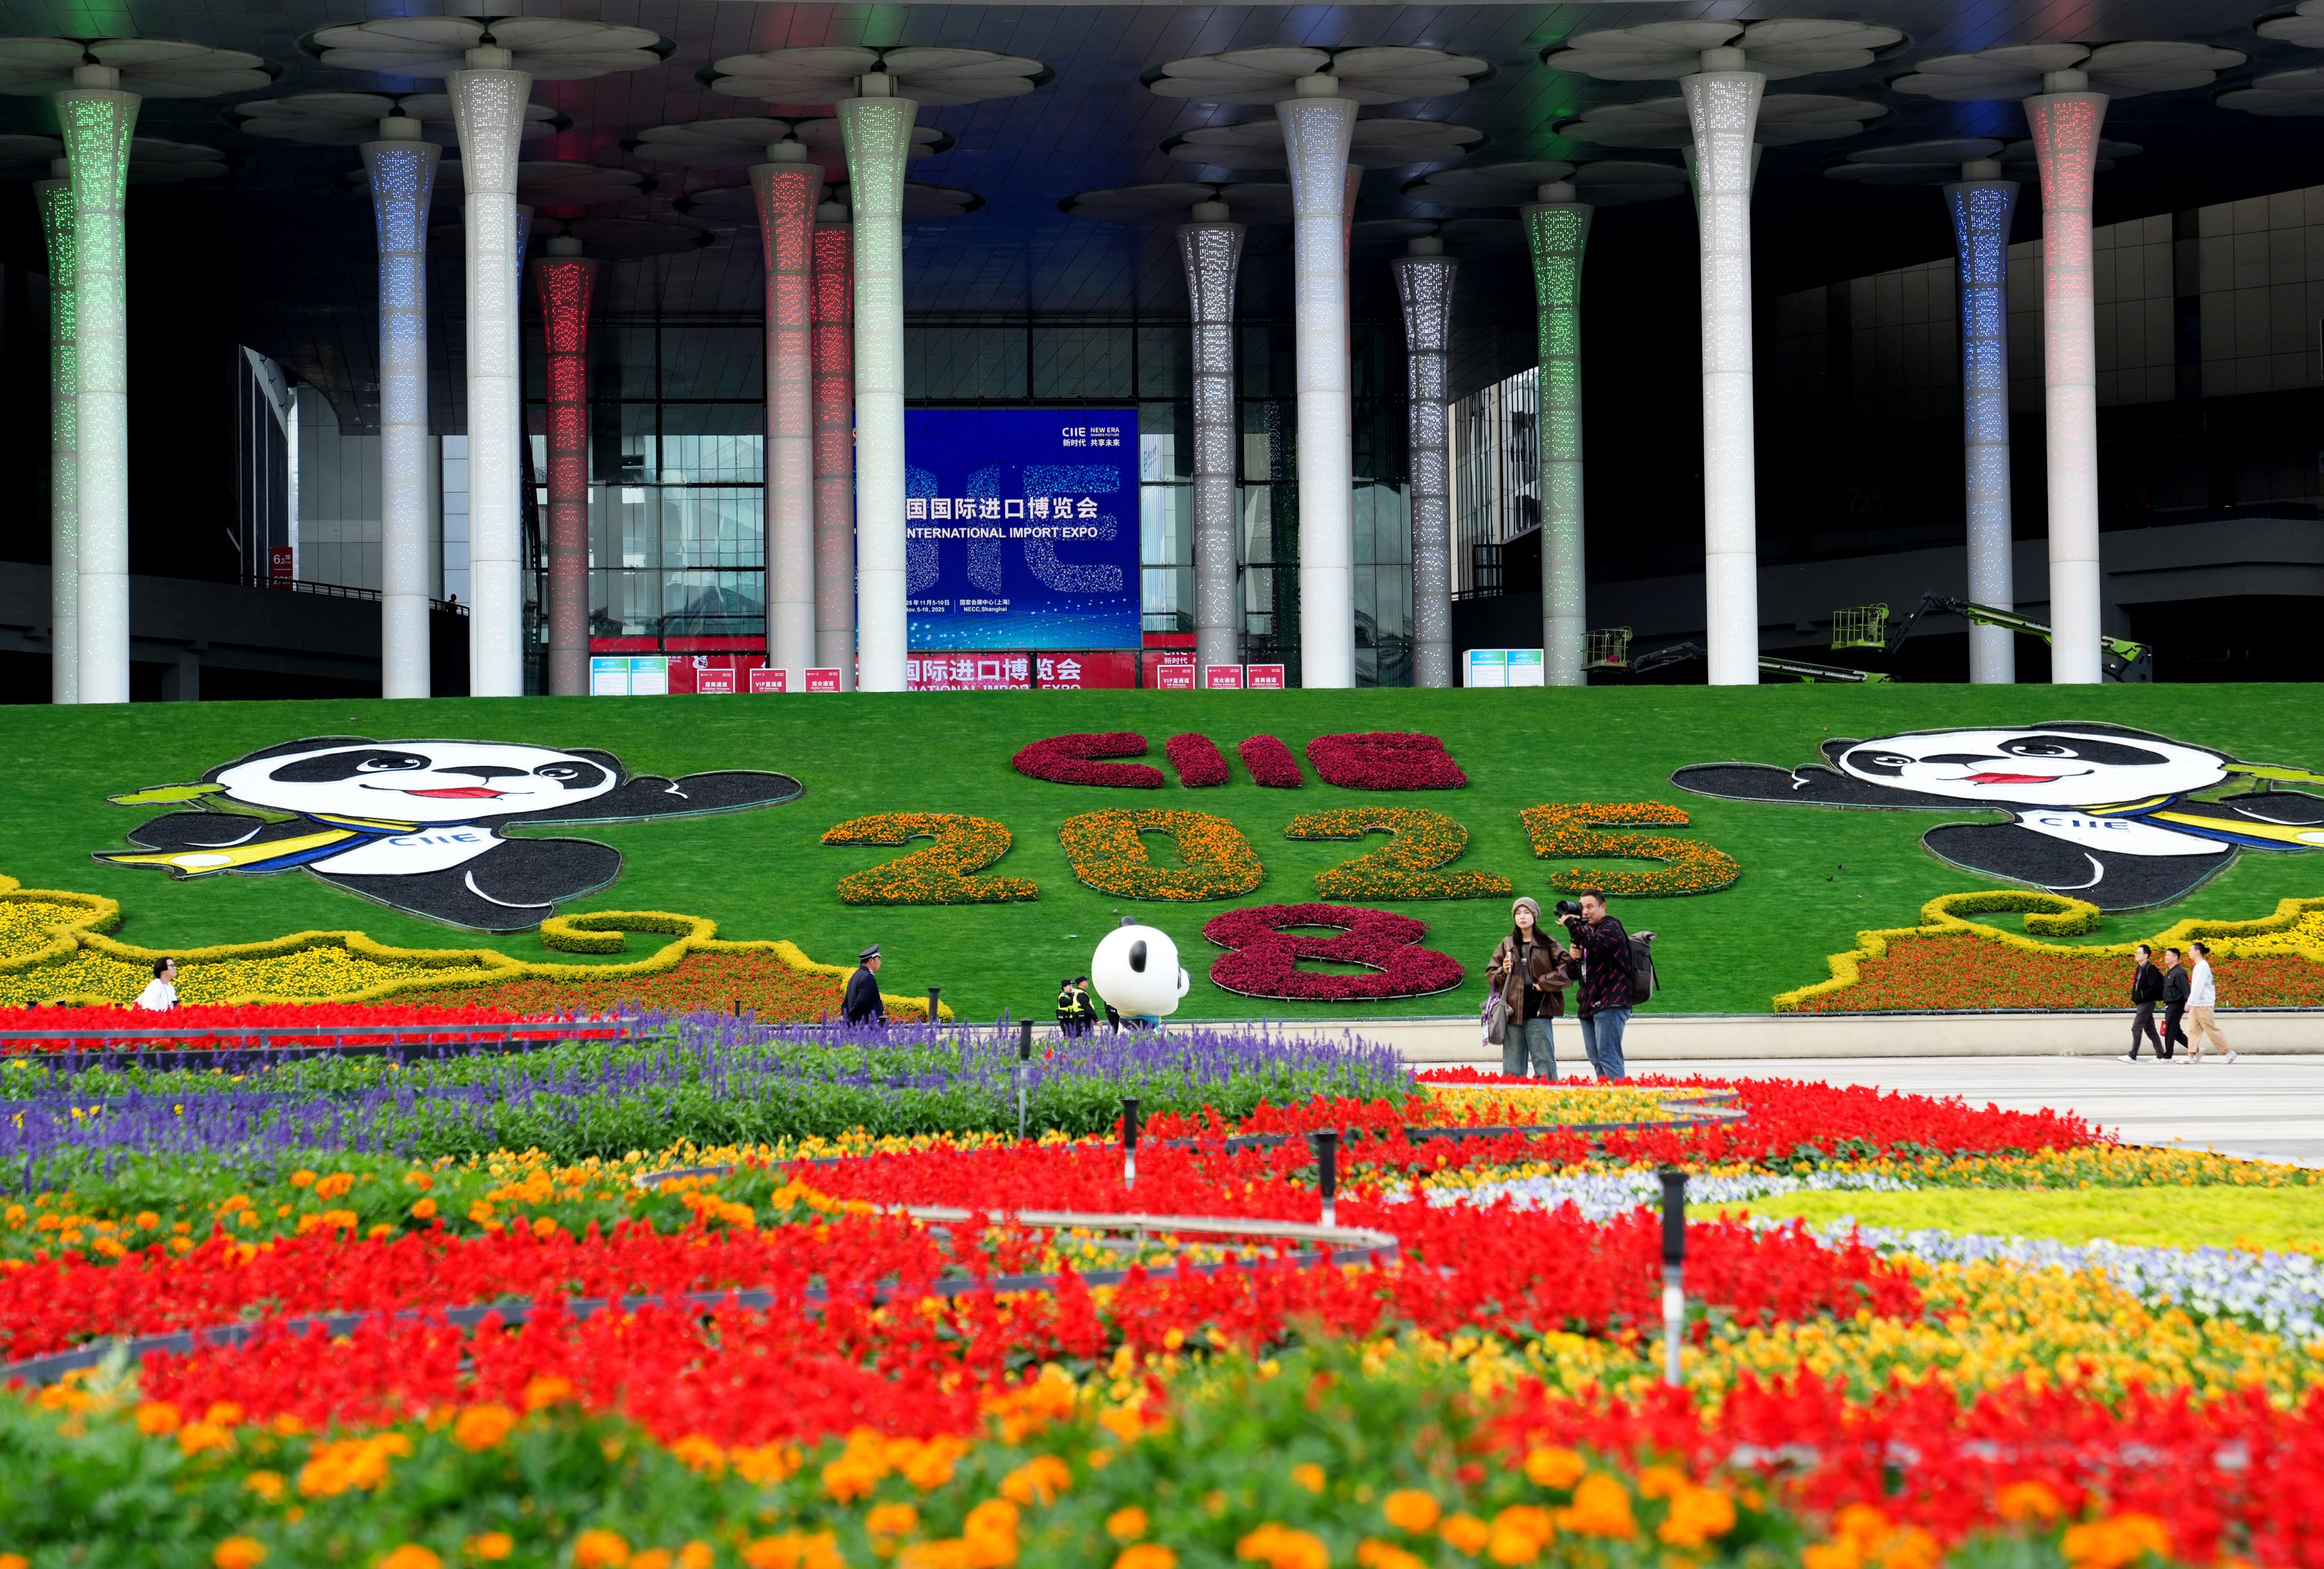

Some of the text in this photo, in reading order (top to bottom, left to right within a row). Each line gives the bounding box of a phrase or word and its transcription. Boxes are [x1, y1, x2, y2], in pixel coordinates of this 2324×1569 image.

[1062, 427, 1086, 437] CIIE
[906, 497, 1098, 519] 国国际进口博览会
[907, 527, 1098, 538] NTERNATIONAL IMPORT EXPO
[274, 555, 285, 564] 6.2
[907, 659, 1082, 682] 国际进口博览会
[1011, 731, 1468, 790] CIIE
[2040, 818, 2128, 829] CIIE
[389, 833, 482, 846] CIIE
[821, 800, 1741, 905] 2025
[1202, 902, 1465, 1002] 8
